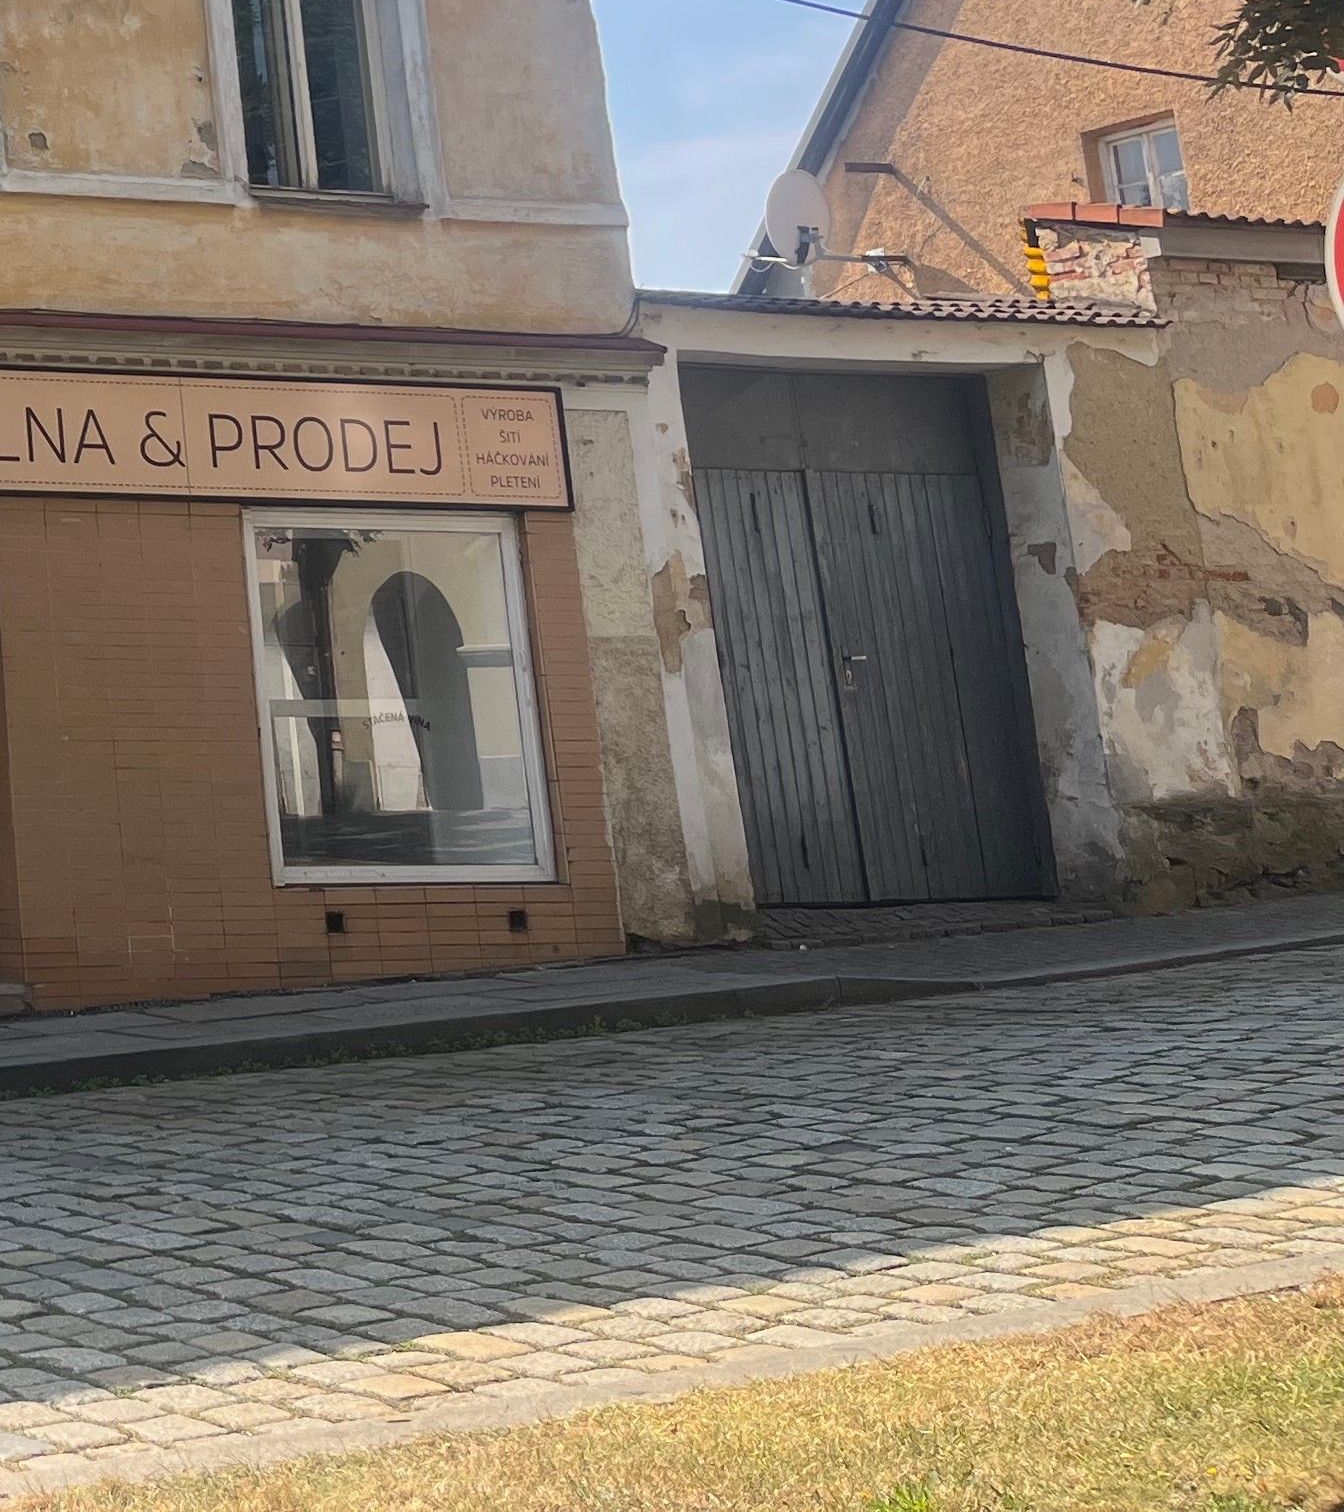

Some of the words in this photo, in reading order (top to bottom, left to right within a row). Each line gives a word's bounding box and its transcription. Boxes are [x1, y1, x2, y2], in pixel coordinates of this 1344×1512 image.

[481, 407, 534, 422] VÝROBA
[140, 410, 186, 468] &
[208, 413, 443, 476] PRODEJ
[475, 450, 549, 467] HÁČKOVÁNÍ
[490, 474, 541, 489] PLETENÍ
